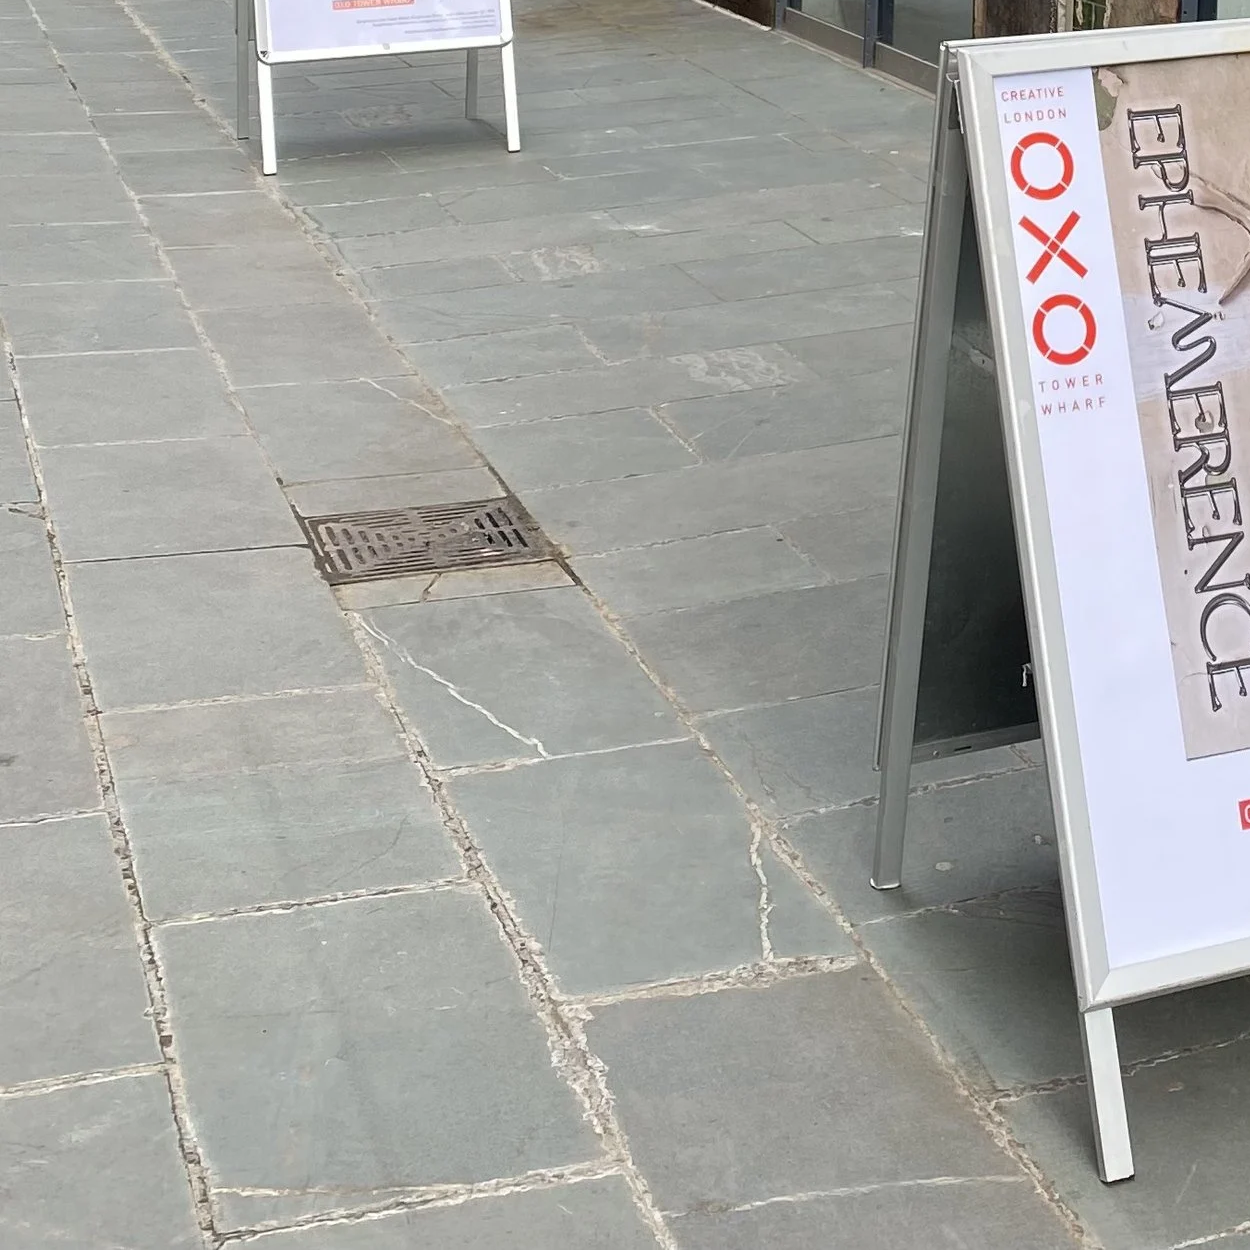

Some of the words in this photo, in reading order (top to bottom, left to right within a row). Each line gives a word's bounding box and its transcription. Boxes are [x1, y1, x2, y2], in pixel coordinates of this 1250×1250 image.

[1001, 86, 1064, 102] CREATIVE
[1004, 108, 1067, 123] LONDON
[1010, 132, 1097, 365] OXO
[1038, 374, 1104, 392] TOWER
[1041, 396, 1106, 415] WHARF
